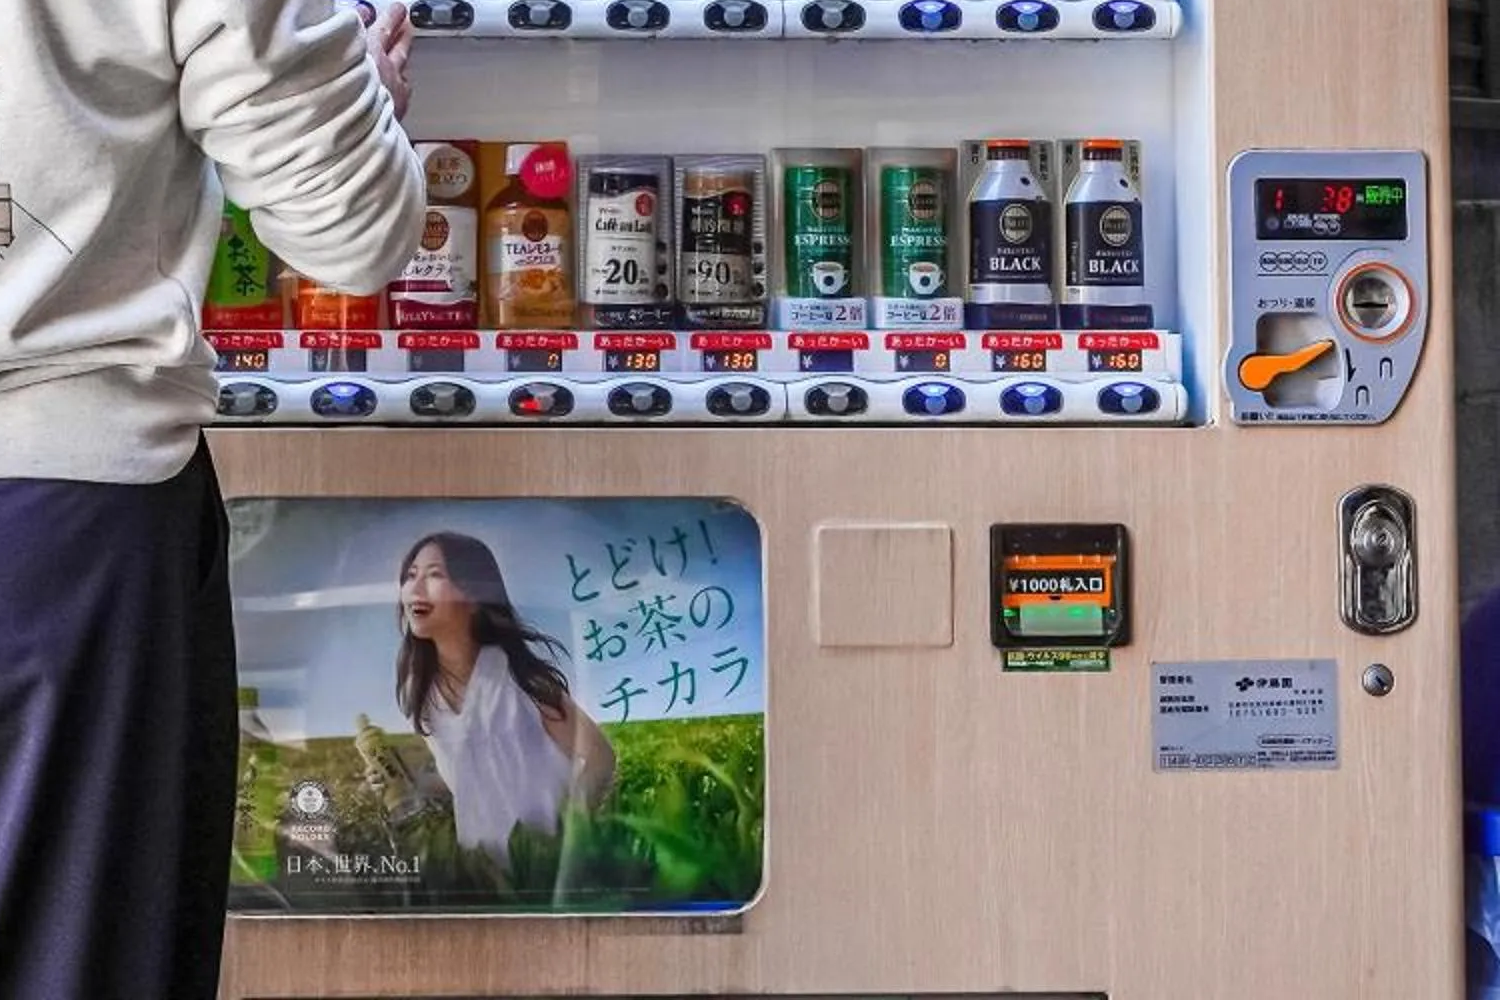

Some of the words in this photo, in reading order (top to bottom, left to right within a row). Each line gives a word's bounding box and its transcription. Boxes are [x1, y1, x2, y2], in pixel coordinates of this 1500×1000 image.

[227, 234, 266, 297] お茶
[605, 258, 639, 285] 20
[698, 259, 731, 286] 90
[989, 257, 1041, 271] BLACK
[1088, 259, 1140, 273] BLACK
[565, 519, 718, 602] とどけ!
[1009, 577, 1103, 593] ¥1000札入口
[583, 586, 735, 661] お茶の
[601, 646, 749, 727] チカラ
